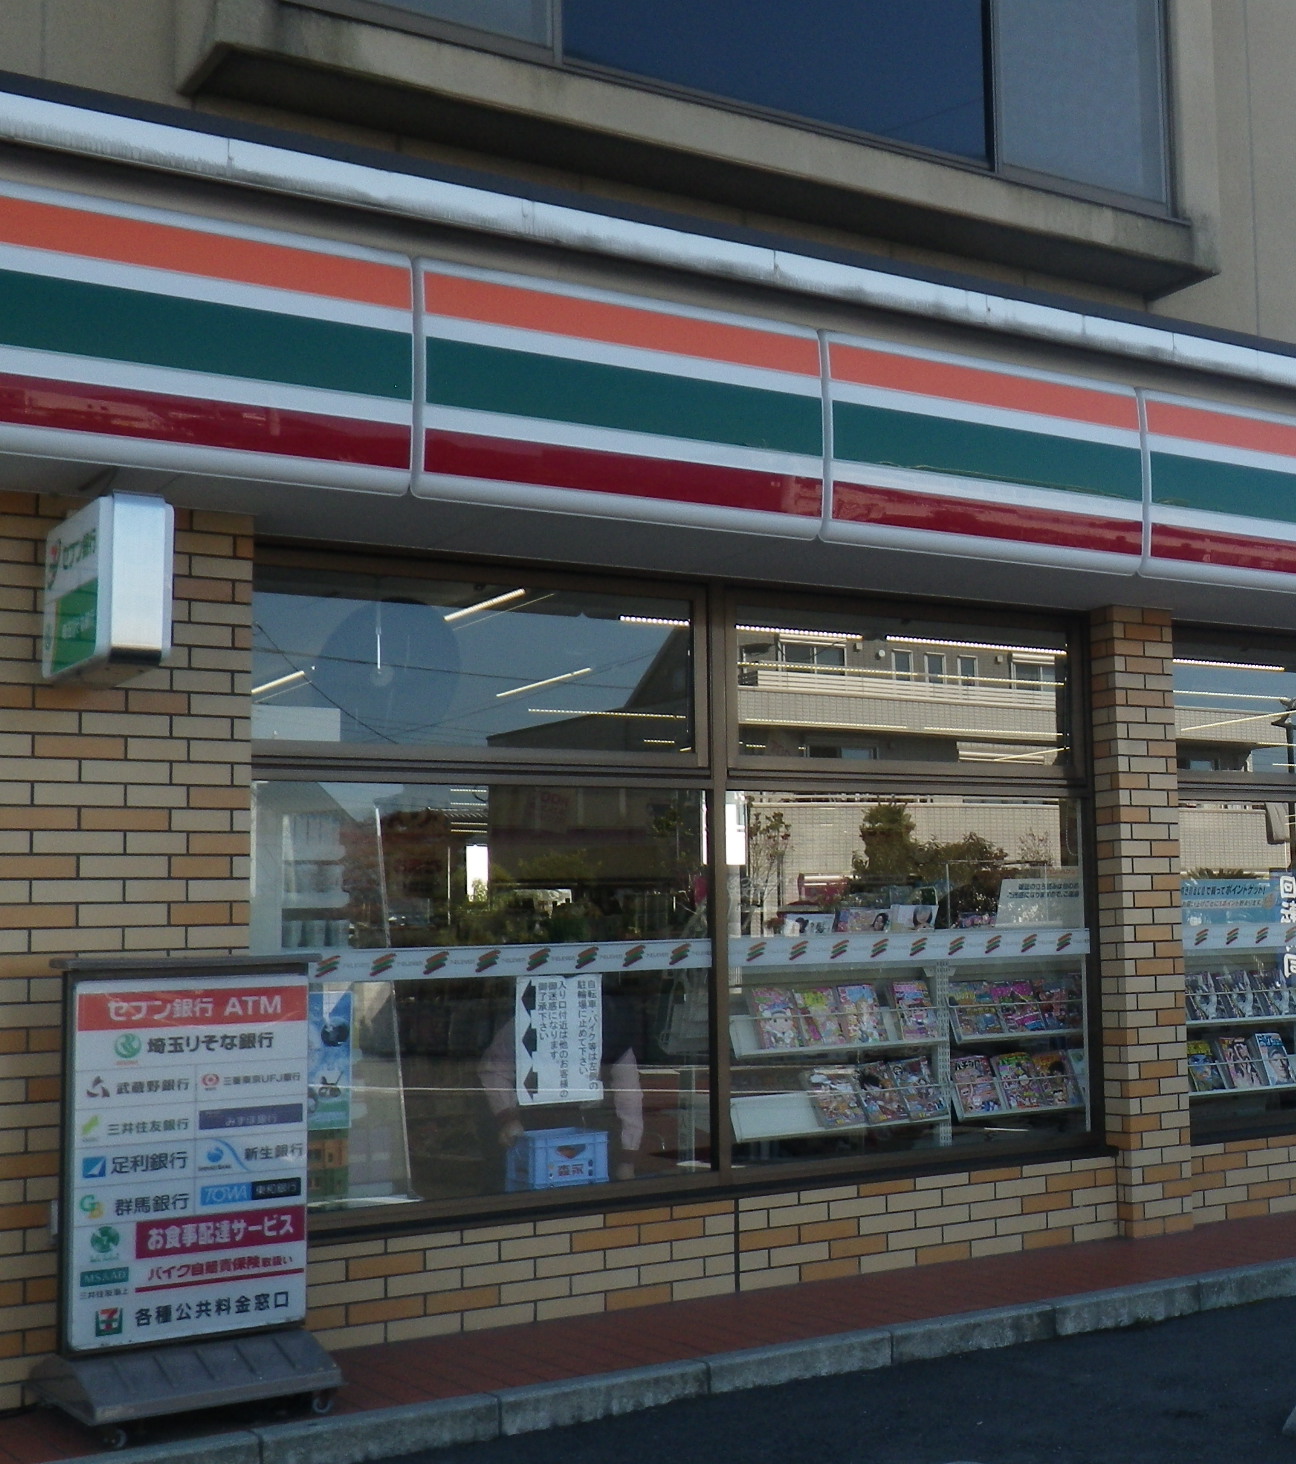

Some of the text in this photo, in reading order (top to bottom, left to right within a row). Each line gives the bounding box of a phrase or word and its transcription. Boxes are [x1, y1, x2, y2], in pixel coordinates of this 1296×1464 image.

[108, 995, 282, 1021] セブン銀行 ATM
[147, 1032, 275, 1054] 埼玉りそな銀行
[116, 1078, 190, 1095] 武蔵野銀行
[223, 1071, 301, 1087] 三菱東京UFJ銀行
[107, 1118, 189, 1135] 三井住友銀行
[111, 1151, 188, 1175] 足利銀行
[244, 1143, 304, 1161] 新生銀行
[115, 1193, 189, 1216] 群馬銀行
[203, 1184, 248, 1205] TOWA
[148, 1214, 294, 1250] お食事配達サービス
[135, 1291, 289, 1327] 各種公共料金窓口
